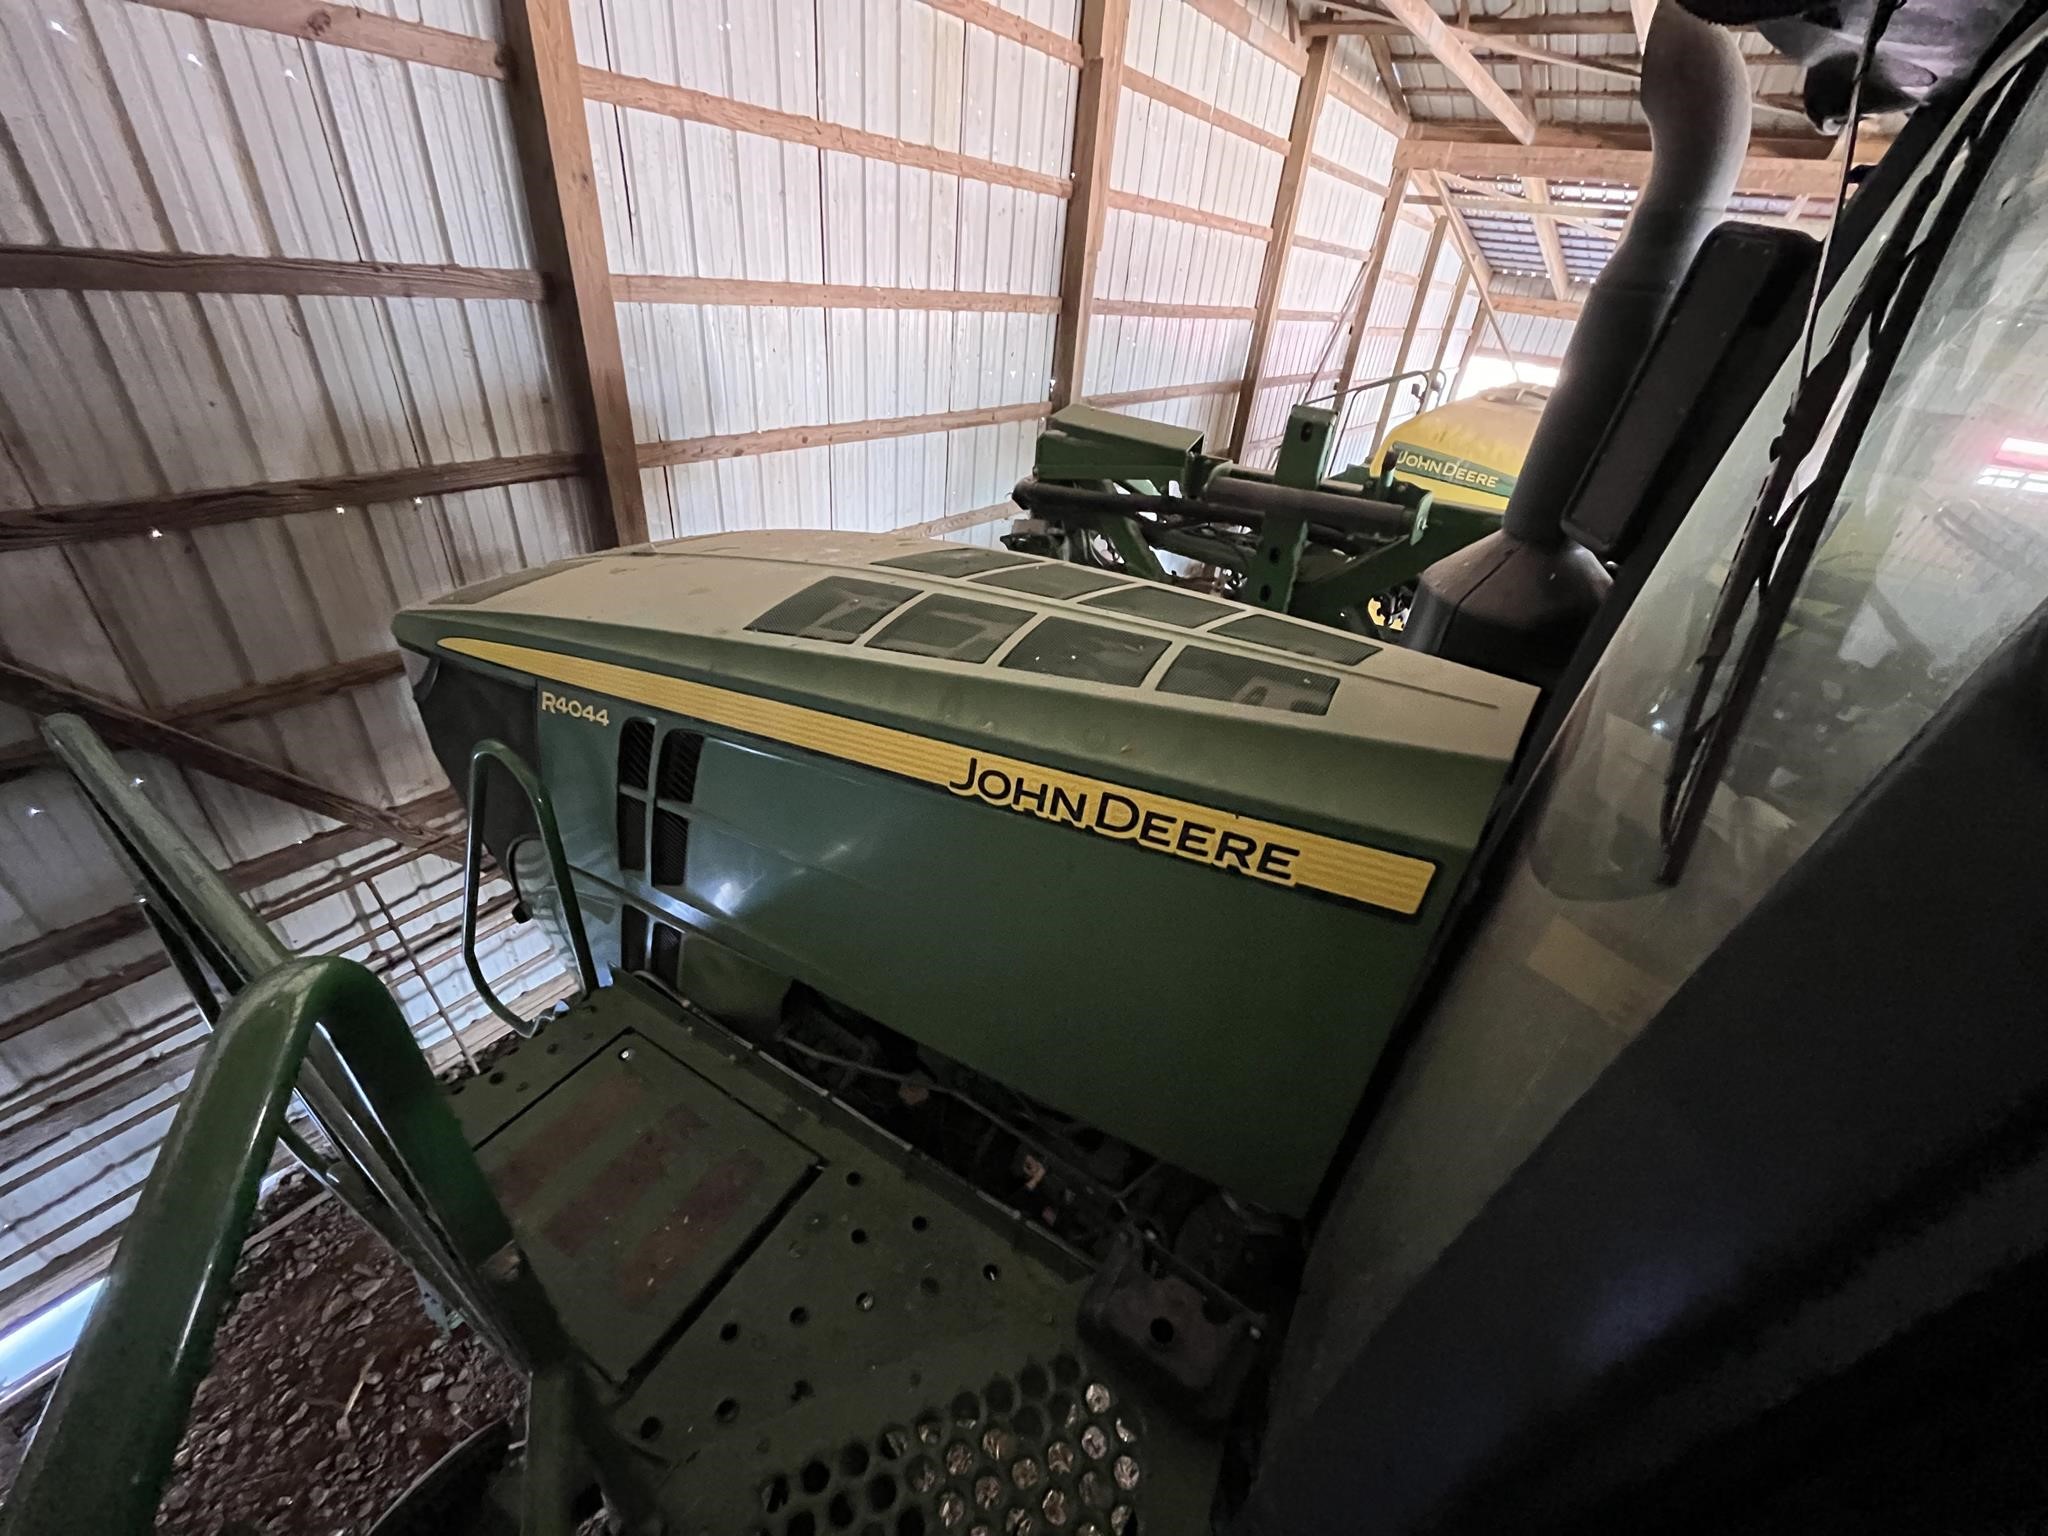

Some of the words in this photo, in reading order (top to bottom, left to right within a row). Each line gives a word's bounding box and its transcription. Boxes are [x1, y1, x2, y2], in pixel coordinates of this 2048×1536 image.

[1397, 451, 1442, 474] JOHN
[1444, 462, 1499, 488] DEERE
[541, 691, 610, 727] R4044
[950, 757, 1088, 822] JOHN
[1095, 792, 1301, 880] DEERE
